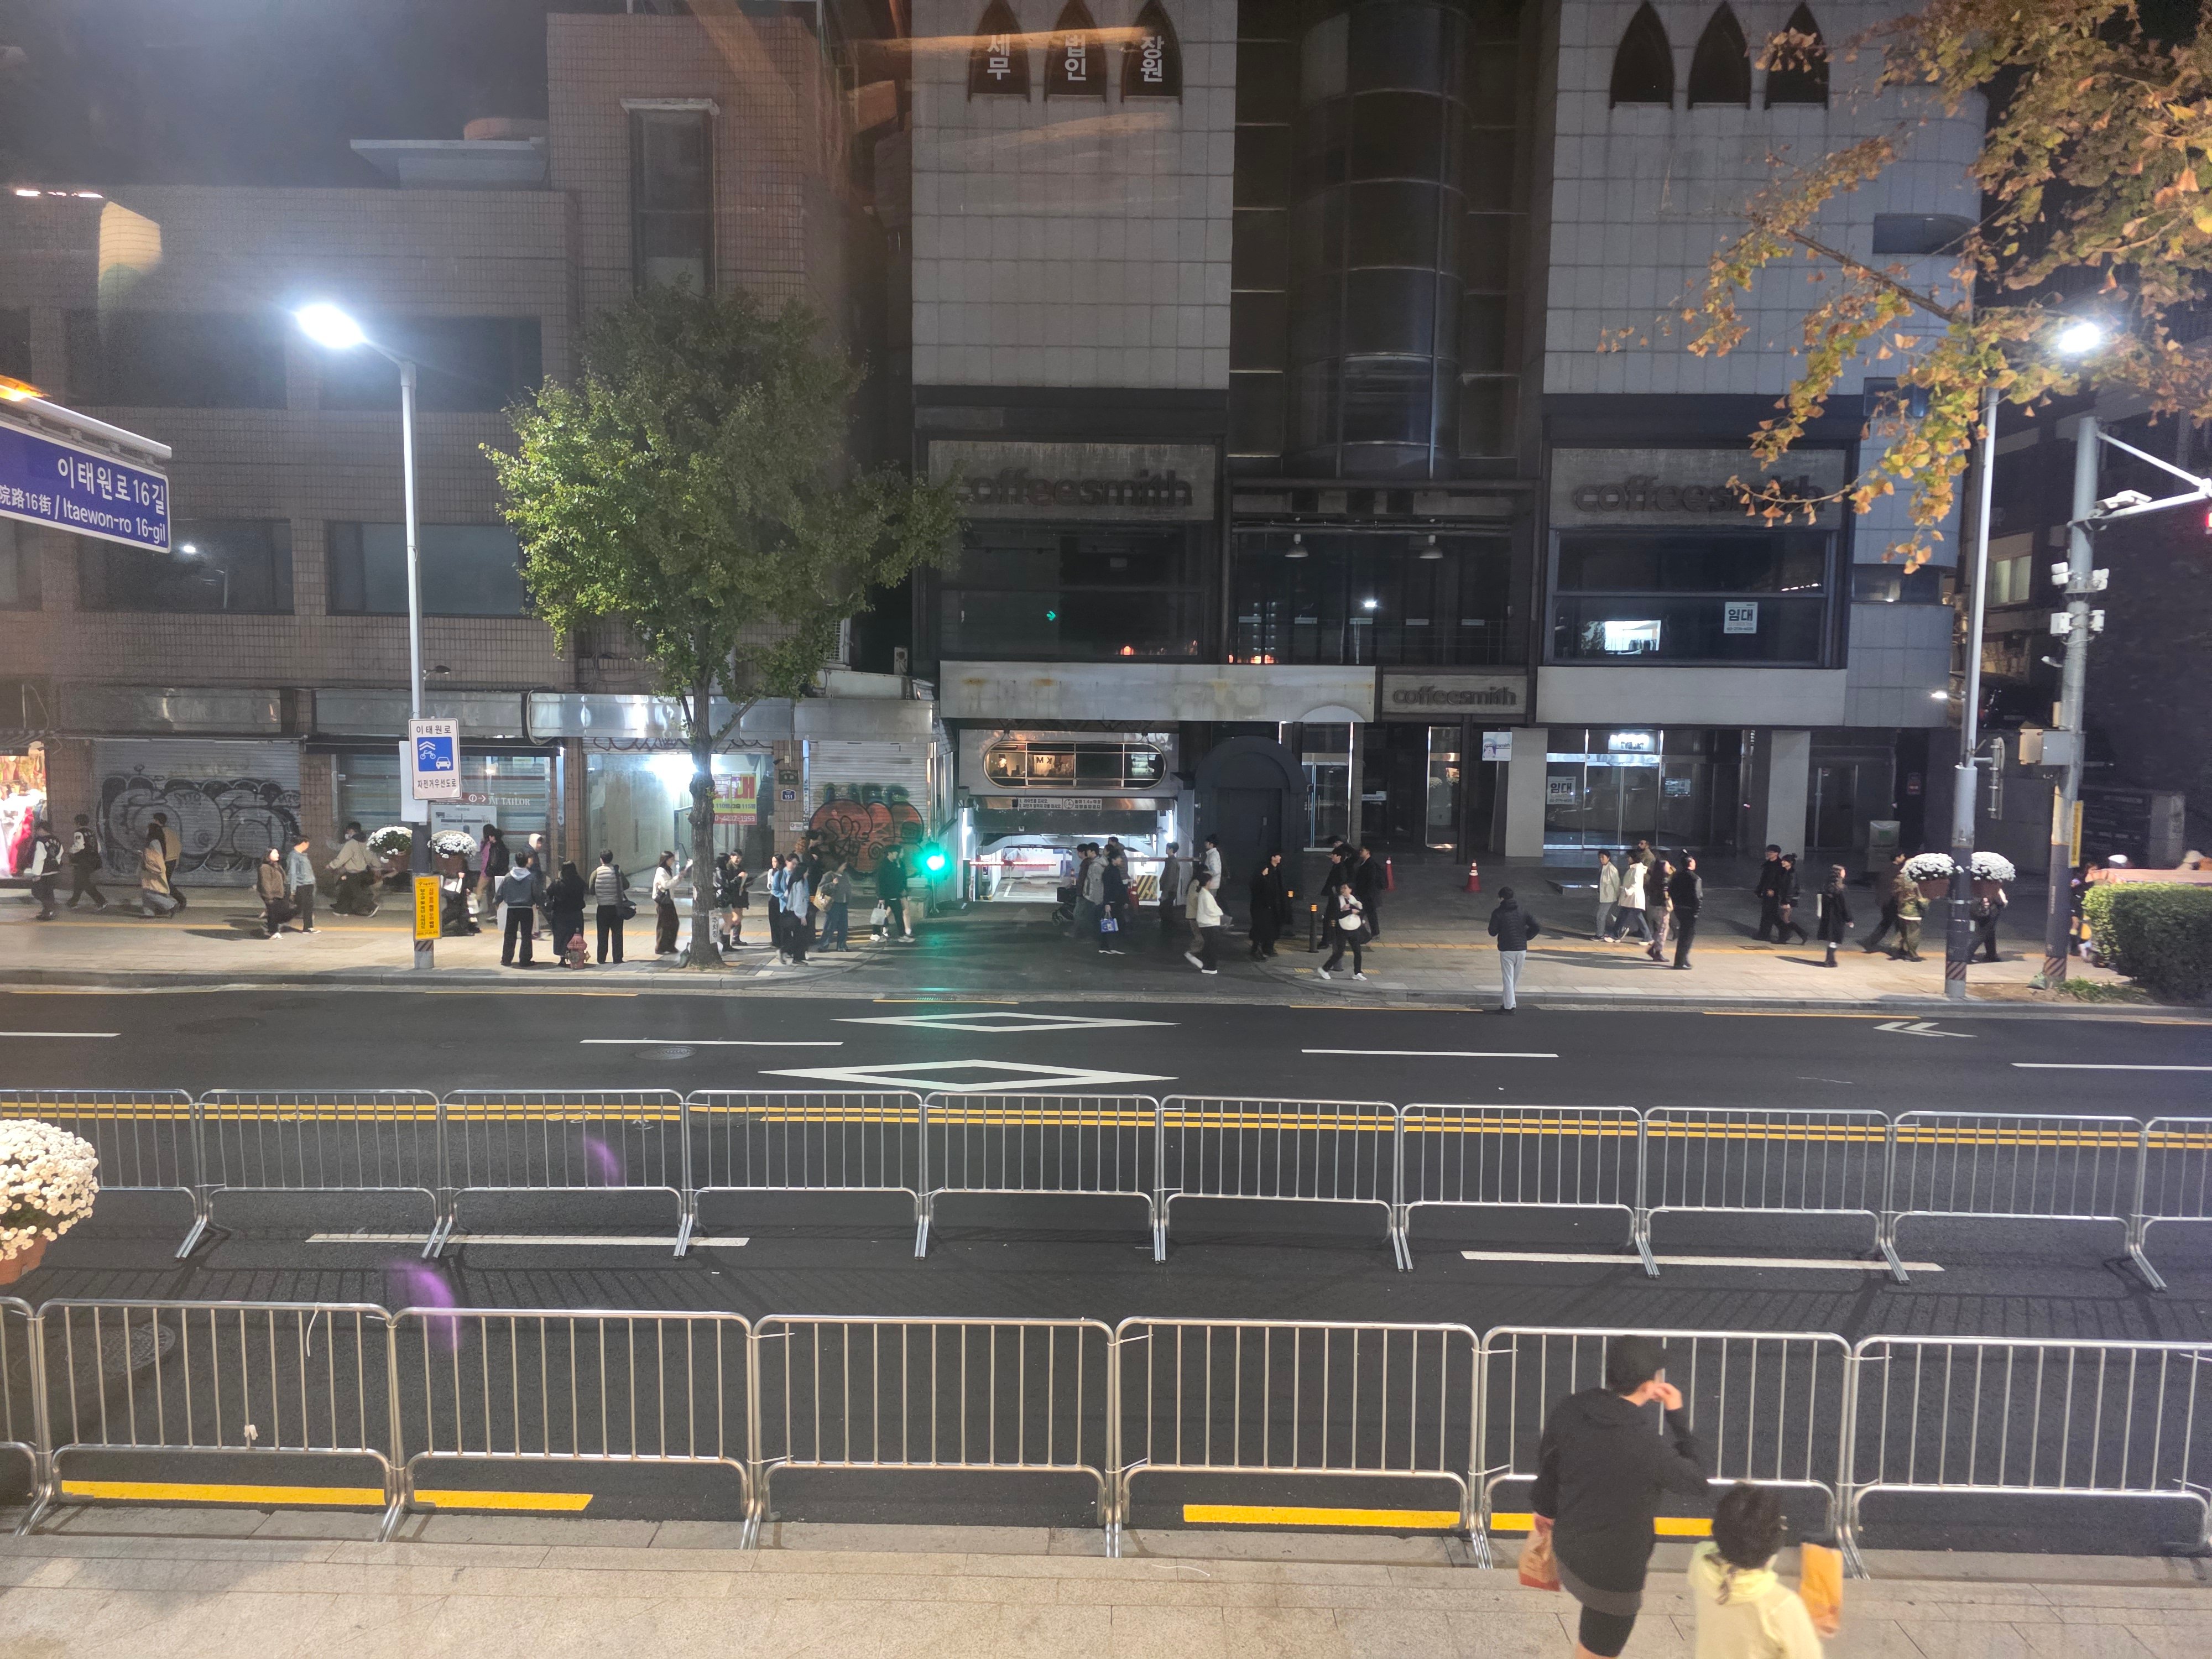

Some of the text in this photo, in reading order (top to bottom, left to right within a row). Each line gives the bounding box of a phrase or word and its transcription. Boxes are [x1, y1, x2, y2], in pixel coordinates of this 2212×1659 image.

[987, 34, 1164, 82] 세무 법인 장원
[63, 498, 132, 533] Itaewon-ro
[136, 517, 166, 544] 16-gil
[1728, 609, 1753, 621] 임대
[1392, 685, 1516, 705] coffeesmith
[416, 725, 452, 734] 이태원로
[417, 779, 457, 789] 자전거우선도로
[1550, 782, 1572, 794] 임대
